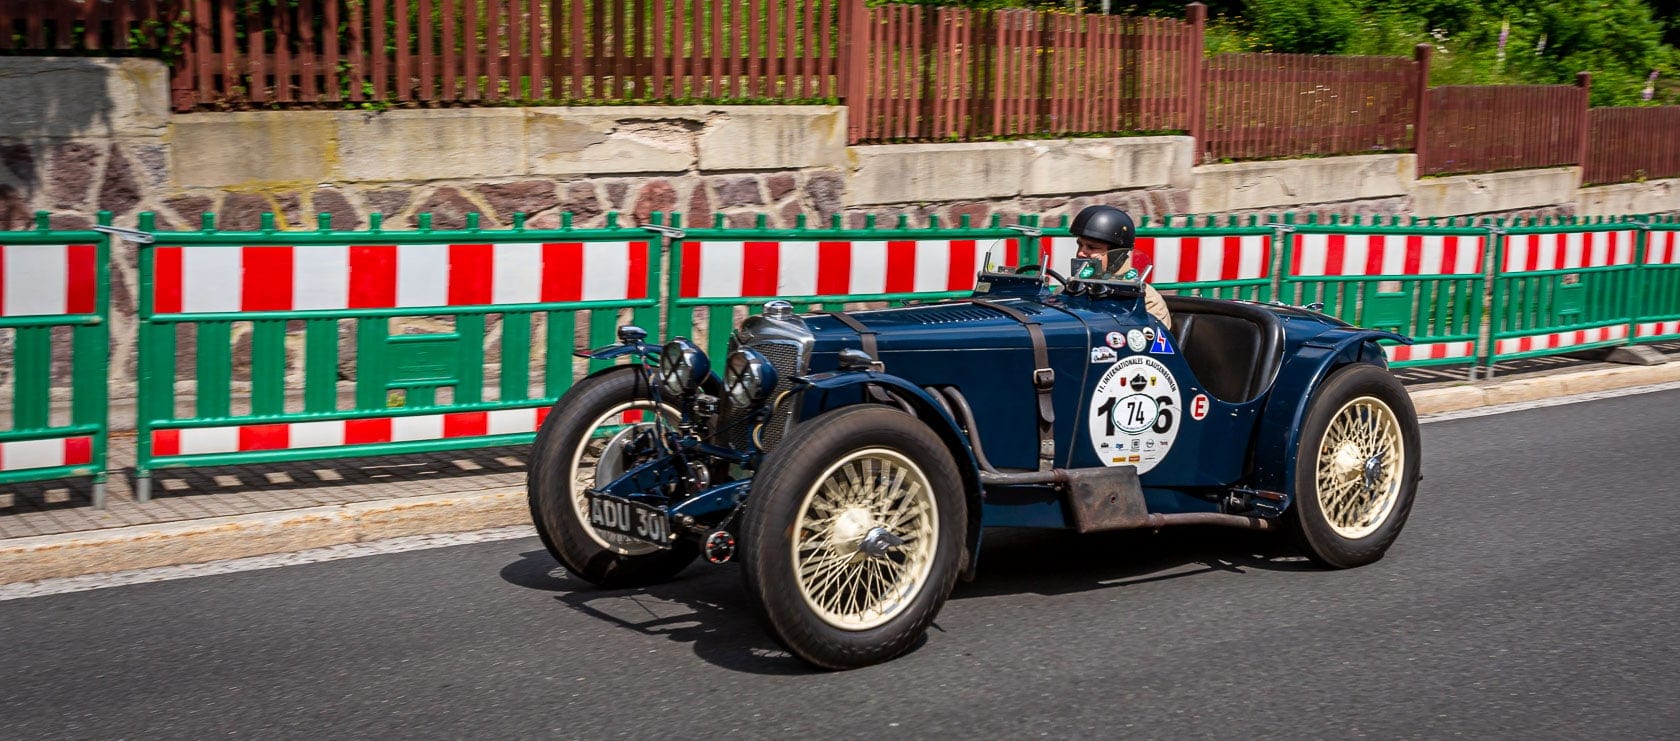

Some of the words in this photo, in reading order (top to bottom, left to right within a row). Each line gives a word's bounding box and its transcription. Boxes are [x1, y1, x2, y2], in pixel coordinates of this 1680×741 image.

[1104, 358, 1143, 384] INTERNATIONALES
[1146, 359, 1176, 392] KLAUSENRENNEN
[1097, 396, 1174, 437] 16
[1127, 401, 1145, 425] 74
[1195, 397, 1206, 417] E
[591, 498, 631, 532] ADU
[635, 508, 668, 543] 301
